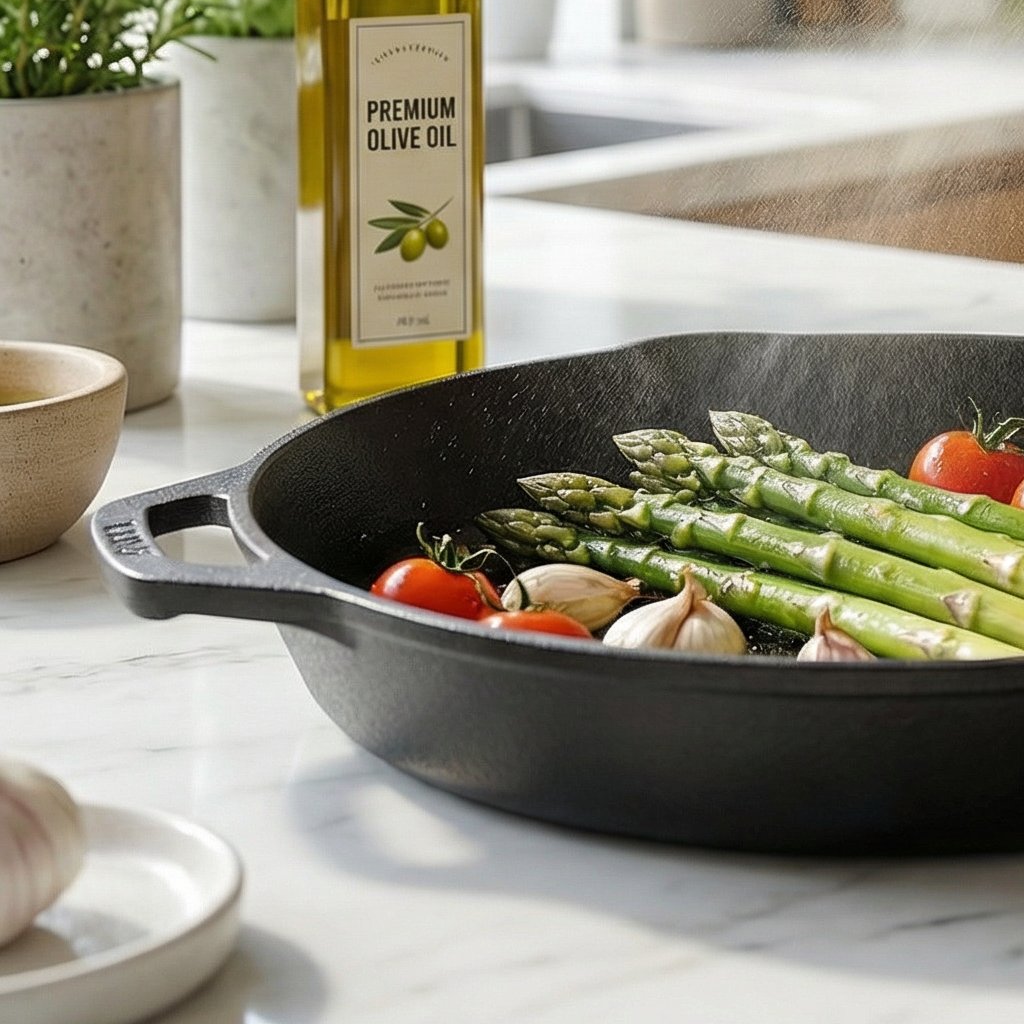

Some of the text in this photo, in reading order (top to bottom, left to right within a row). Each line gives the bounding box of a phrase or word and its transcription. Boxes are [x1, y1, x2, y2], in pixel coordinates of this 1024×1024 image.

[367, 97, 456, 123] PREMIUM
[367, 125, 457, 151] OLIVE OIL
